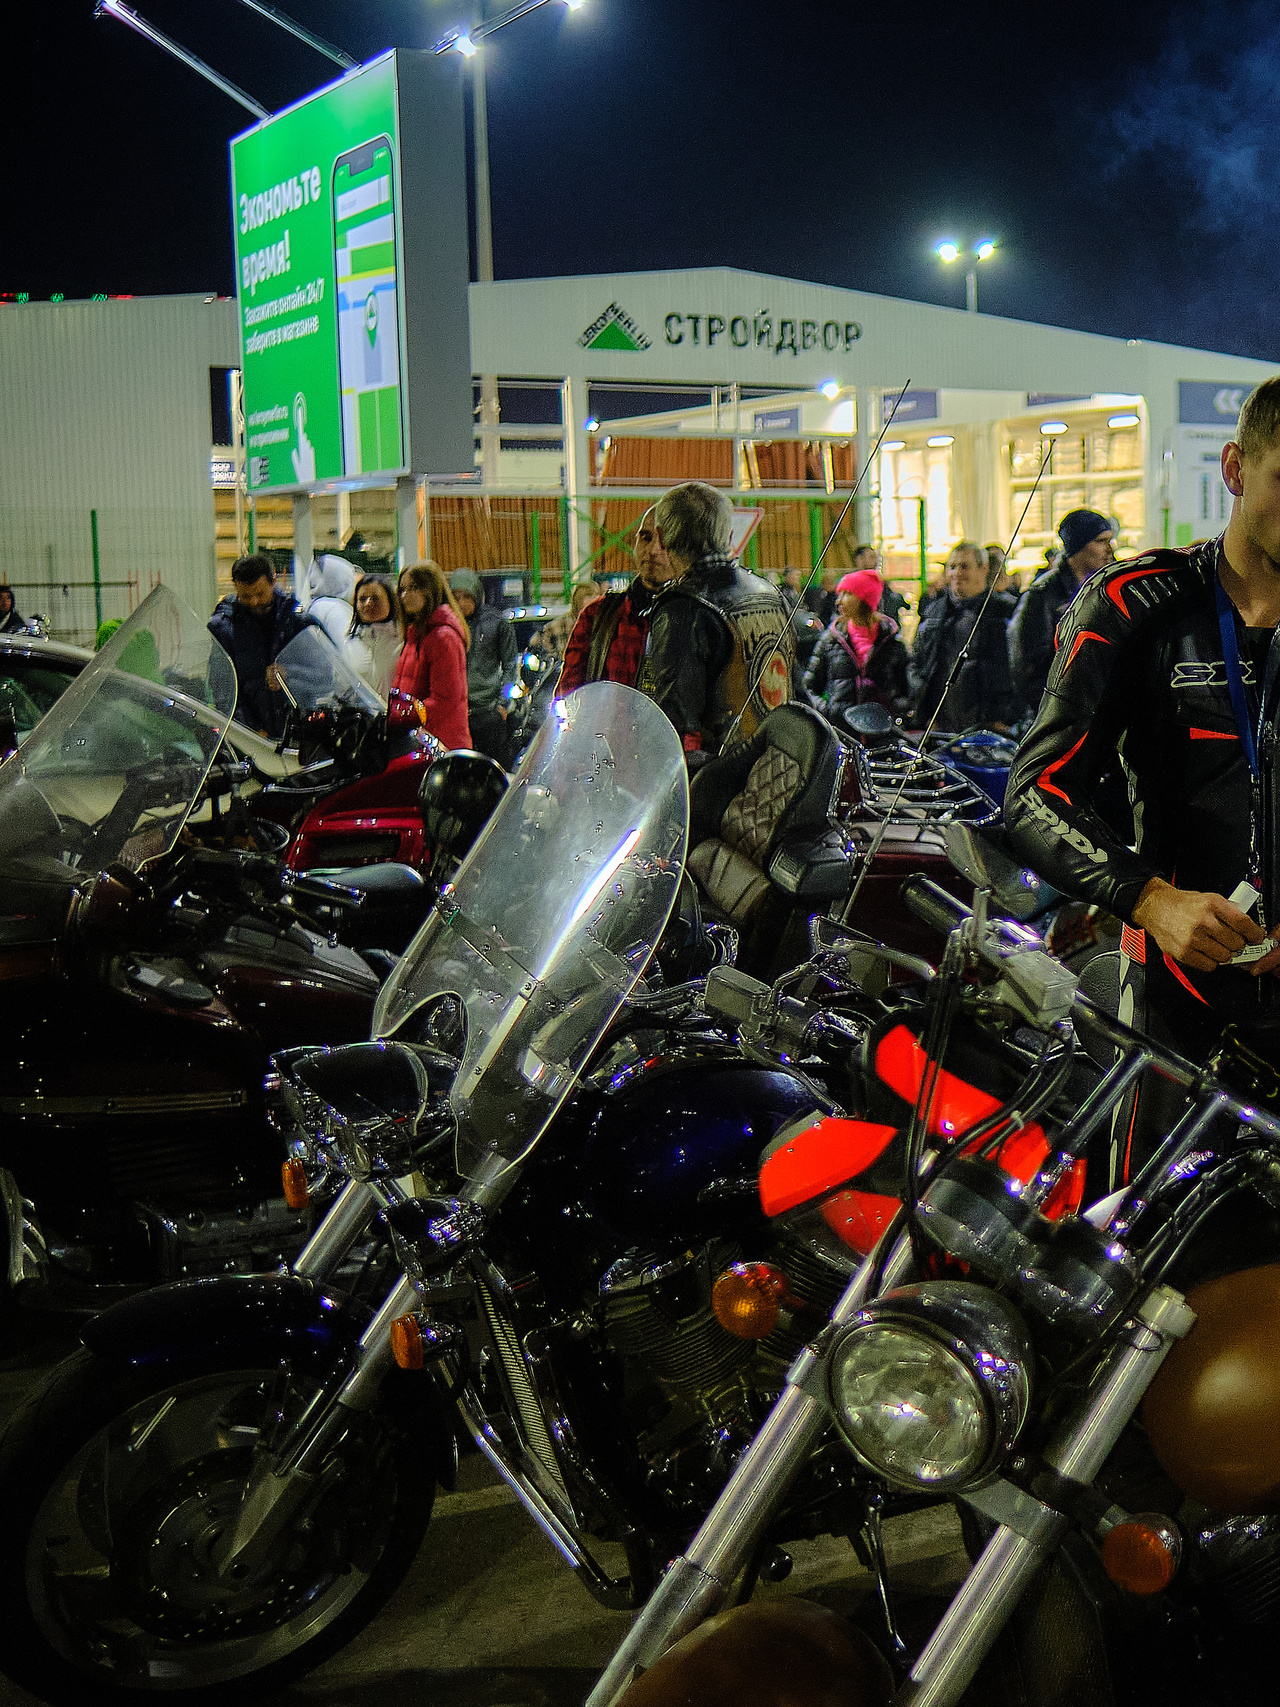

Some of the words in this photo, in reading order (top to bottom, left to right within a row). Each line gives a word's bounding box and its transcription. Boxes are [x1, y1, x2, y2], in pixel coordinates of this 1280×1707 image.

[240, 166, 321, 235] Экономьте
[242, 229, 291, 297] время!
[664, 308, 863, 356] СТРОЙДВОР
[1020, 786, 1108, 863] SPIDI
